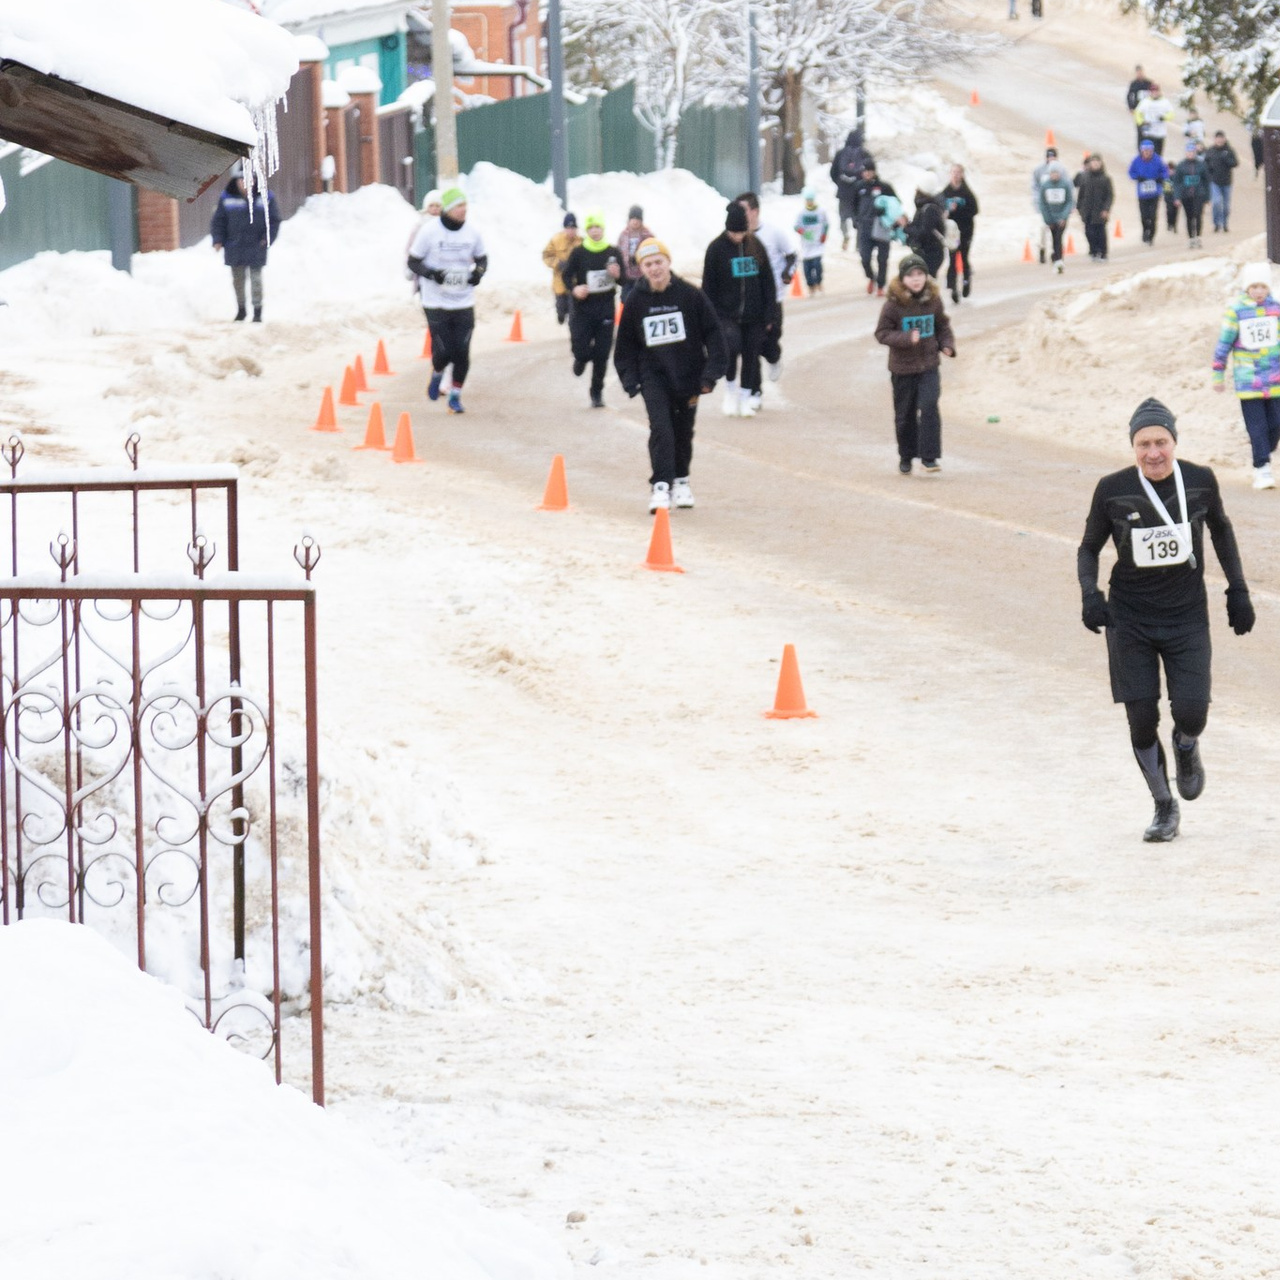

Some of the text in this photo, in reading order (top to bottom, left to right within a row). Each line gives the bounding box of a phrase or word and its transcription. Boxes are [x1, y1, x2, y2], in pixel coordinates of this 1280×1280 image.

[649, 317, 679, 338] 275
[1250, 327, 1271, 343] 154
[1147, 540, 1179, 560] 139
